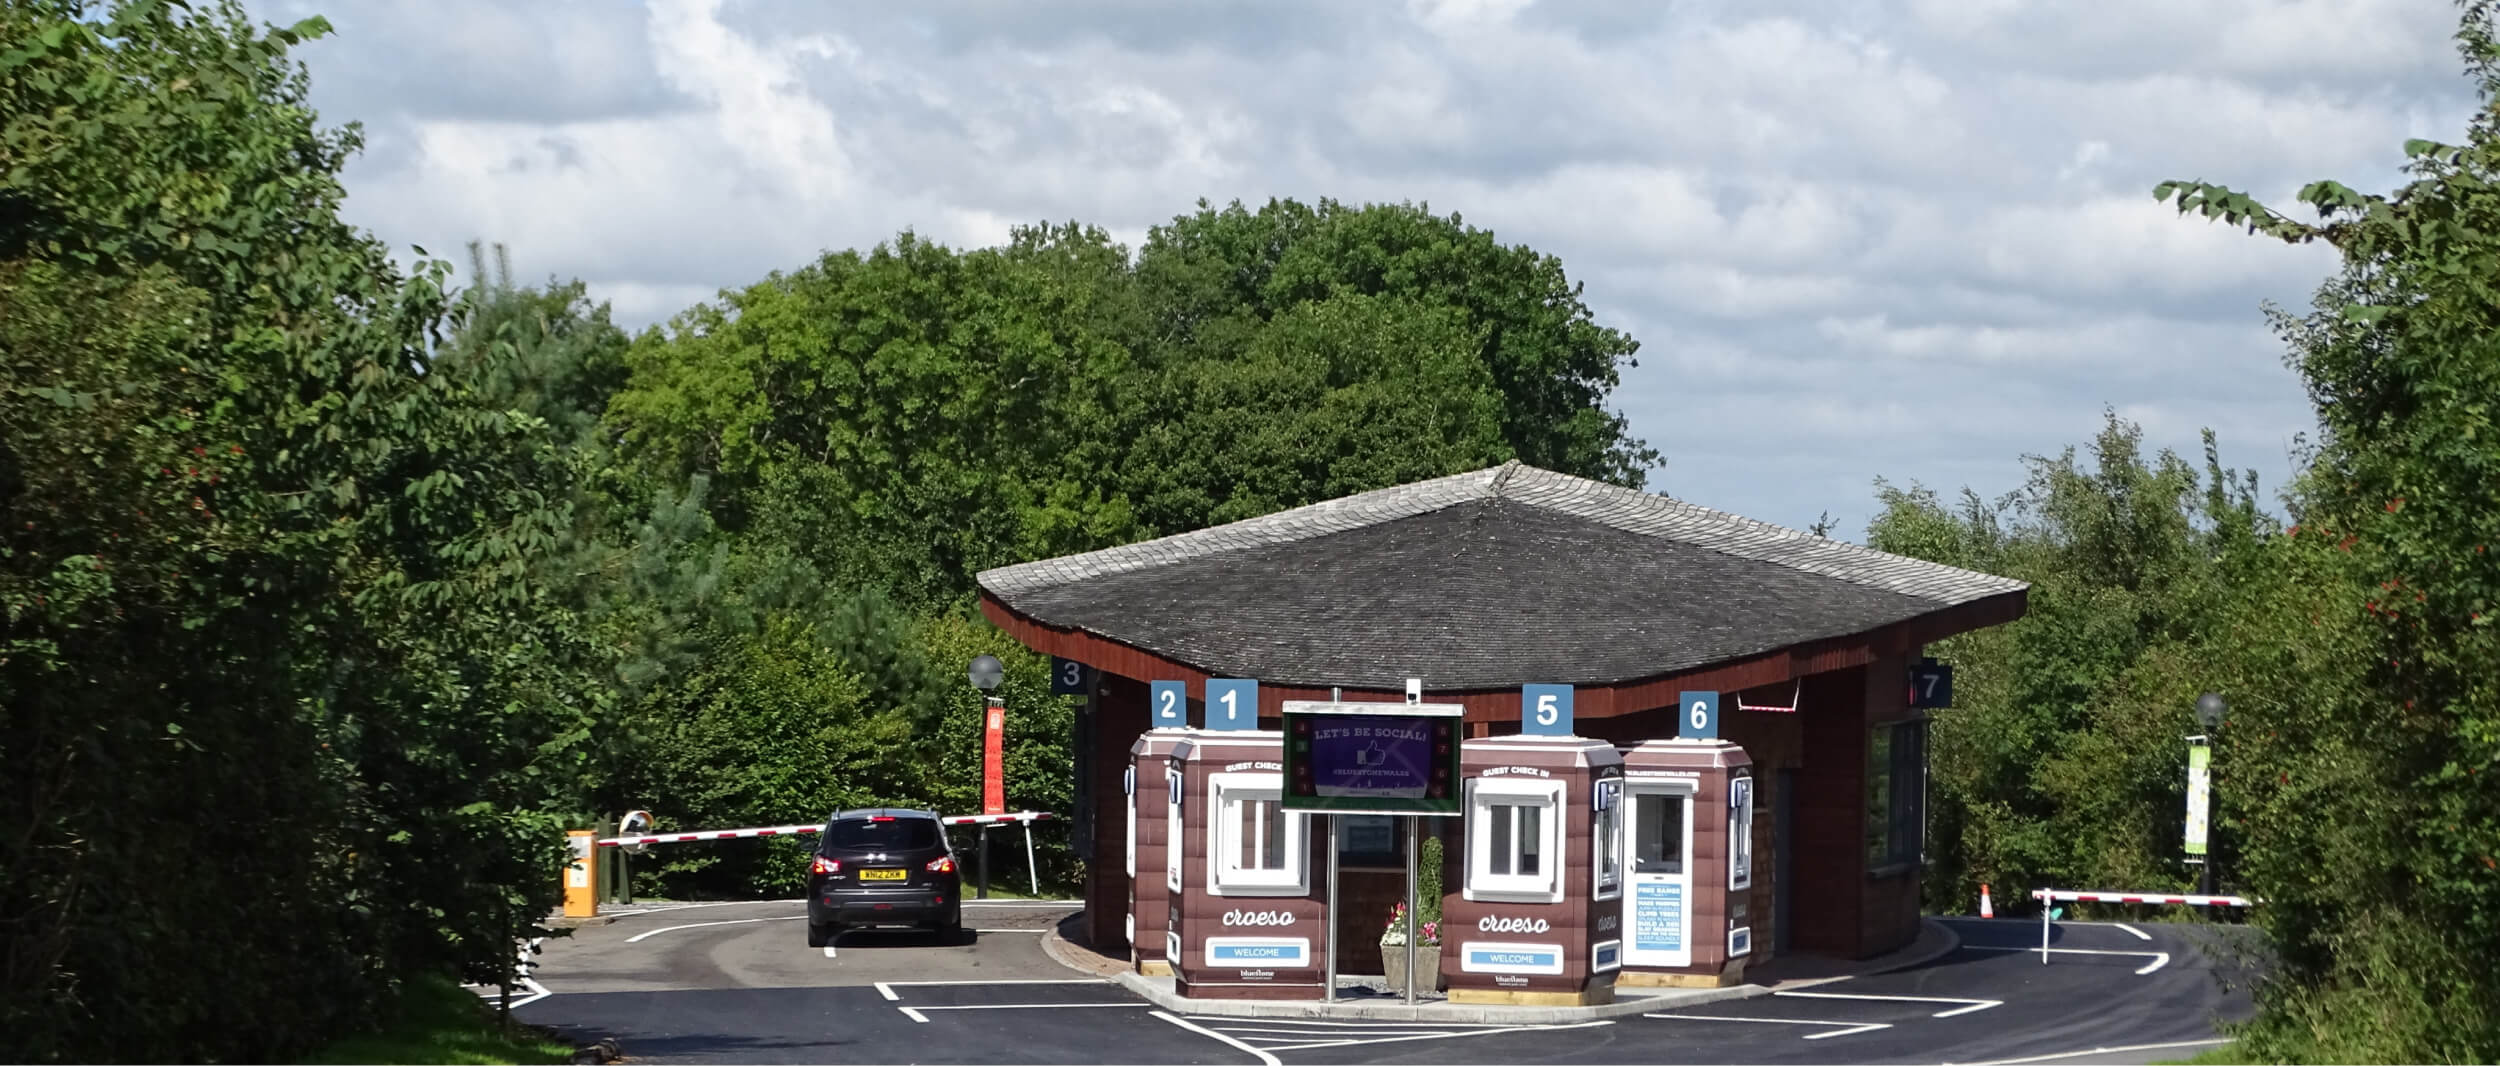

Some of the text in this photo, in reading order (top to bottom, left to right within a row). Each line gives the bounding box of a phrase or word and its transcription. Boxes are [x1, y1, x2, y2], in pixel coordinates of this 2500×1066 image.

[1063, 662, 1080, 686] 3
[1922, 674, 1940, 699] 7
[1160, 689, 1176, 719] 2
[1219, 689, 1237, 720] 1
[1536, 695, 1558, 726] 5
[1690, 701, 1708, 730] 6
[1314, 727, 1427, 742] LET'S BE SOCIAL!
[1225, 762, 1253, 772] GUEST
[1483, 766, 1550, 778] GUEST CHECK IN
[1222, 908, 1296, 926] croeso
[1478, 914, 1550, 934] croeso
[1234, 948, 1280, 957] WELCOME
[1489, 953, 1535, 964] WELCOME
